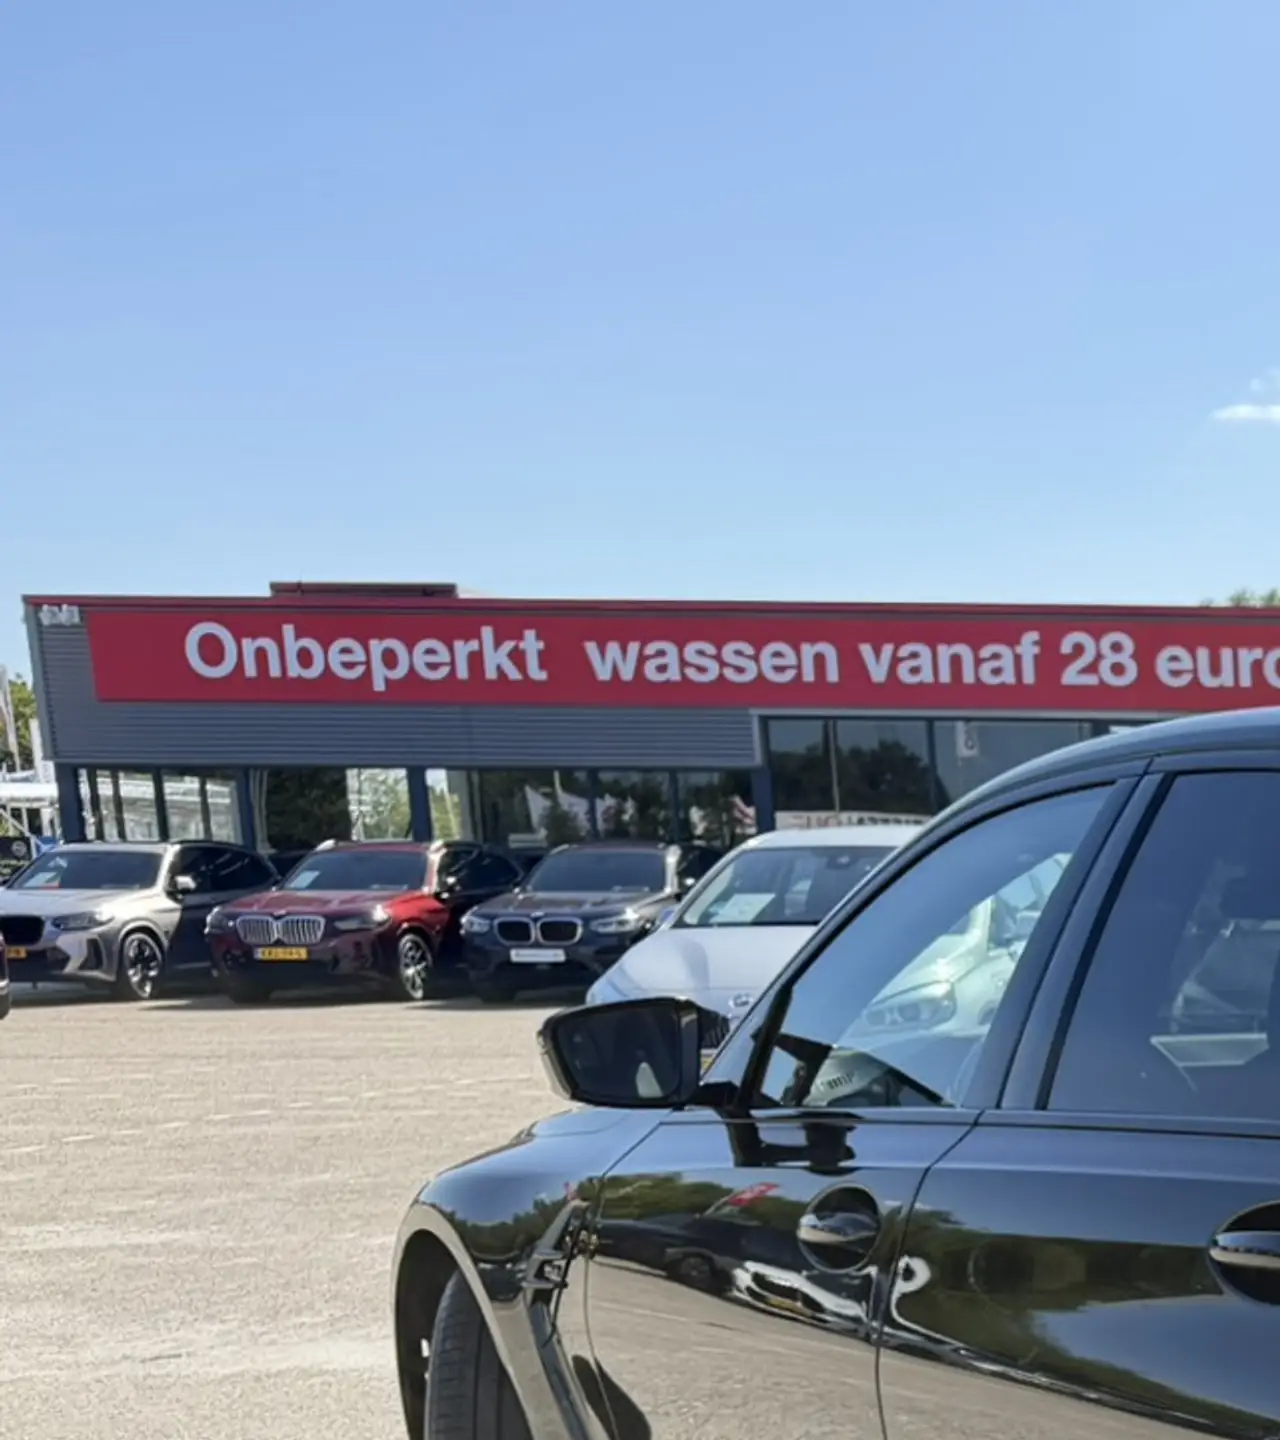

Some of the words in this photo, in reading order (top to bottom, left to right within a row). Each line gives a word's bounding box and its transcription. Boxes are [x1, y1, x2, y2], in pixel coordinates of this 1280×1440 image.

[184, 622, 548, 692] Onbeperkt
[584, 640, 839, 683] wassen
[858, 630, 1041, 685] vanaf
[1060, 631, 1138, 687] 28
